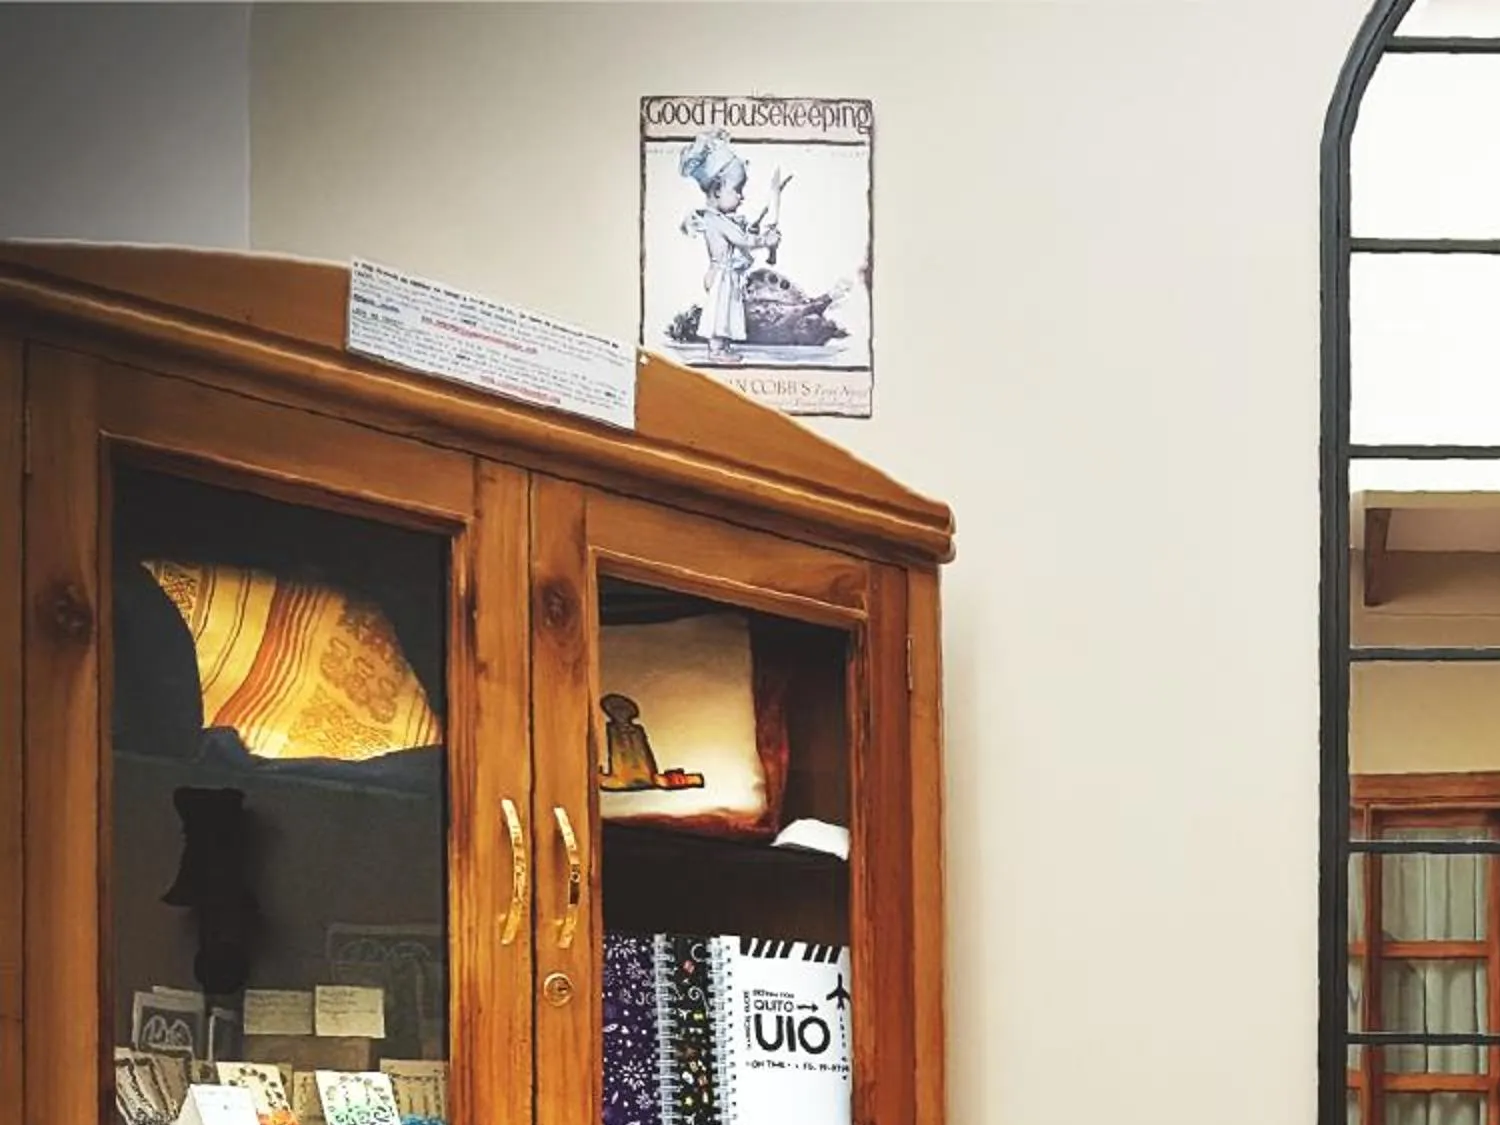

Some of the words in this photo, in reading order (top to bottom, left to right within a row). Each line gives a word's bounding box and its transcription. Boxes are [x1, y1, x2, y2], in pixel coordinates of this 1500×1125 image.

[645, 101, 706, 125] Good
[711, 101, 870, 135] Housekeeping
[753, 999, 794, 1013] QUITO
[753, 1013, 831, 1055] UIO
